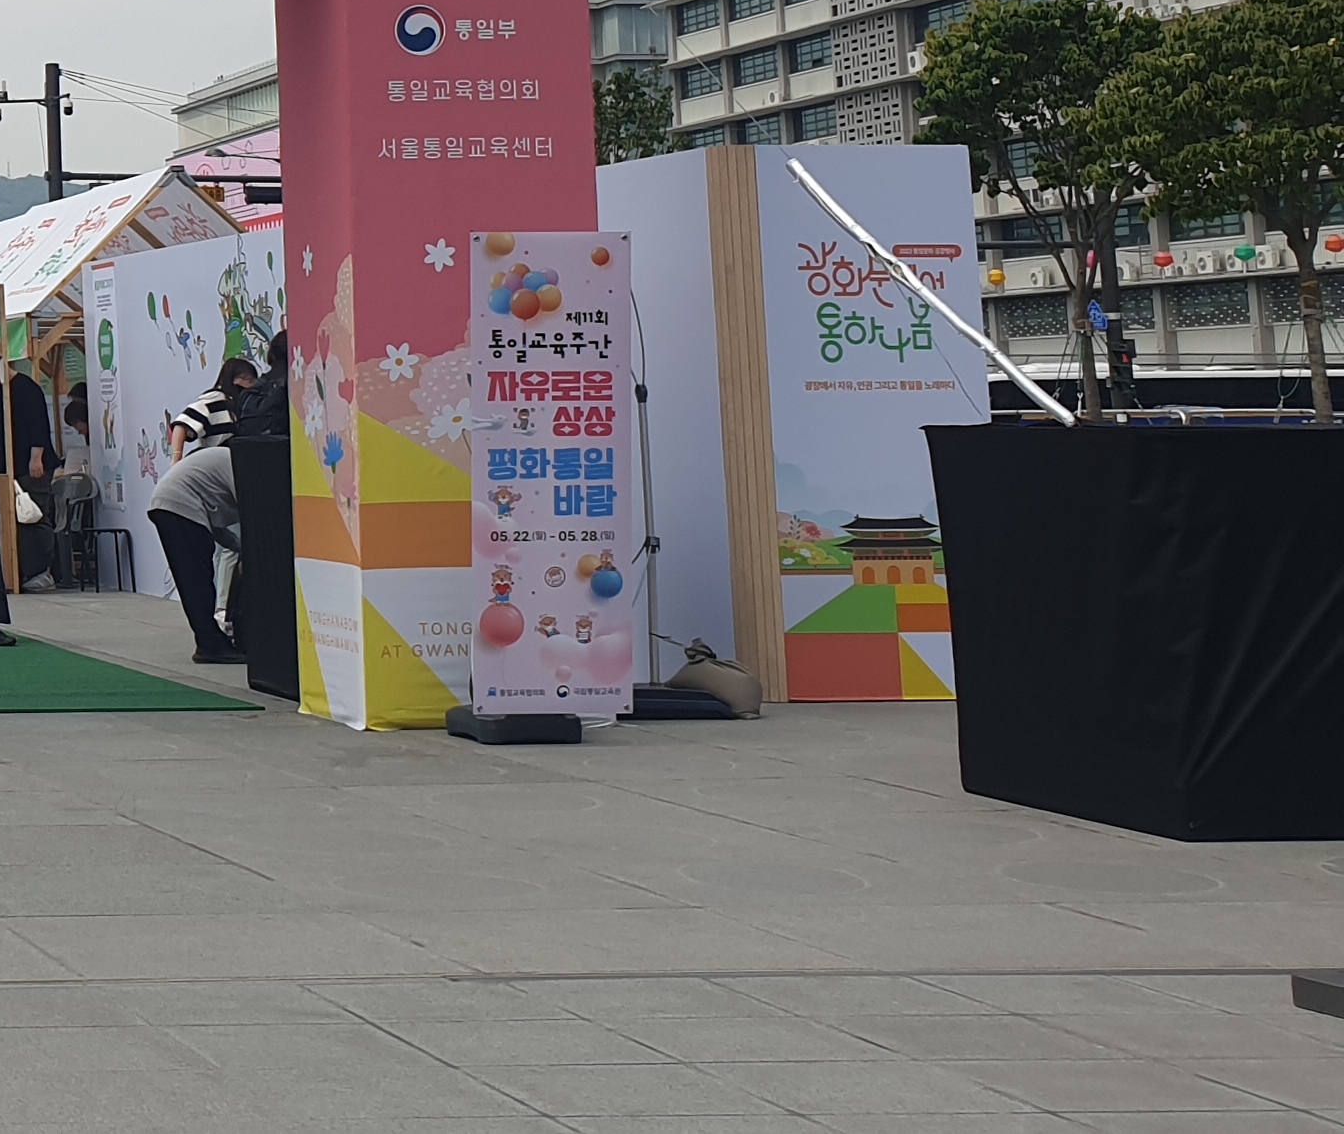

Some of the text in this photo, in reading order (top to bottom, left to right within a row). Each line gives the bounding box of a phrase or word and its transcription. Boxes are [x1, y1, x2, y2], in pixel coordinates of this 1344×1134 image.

[454, 19, 517, 41] 통일부
[387, 78, 540, 103] 통일교육협의회
[377, 136, 554, 160] 서울통일교육센터
[565, 310, 609, 326] 제11회
[487, 329, 613, 363] 통일교육주간
[486, 371, 613, 402] 자유로운
[552, 406, 616, 437] 상상
[486, 447, 615, 481] 평화통일
[553, 484, 618, 518] 바람
[419, 622, 473, 636] TONG
[381, 643, 470, 659] AT GWAN
